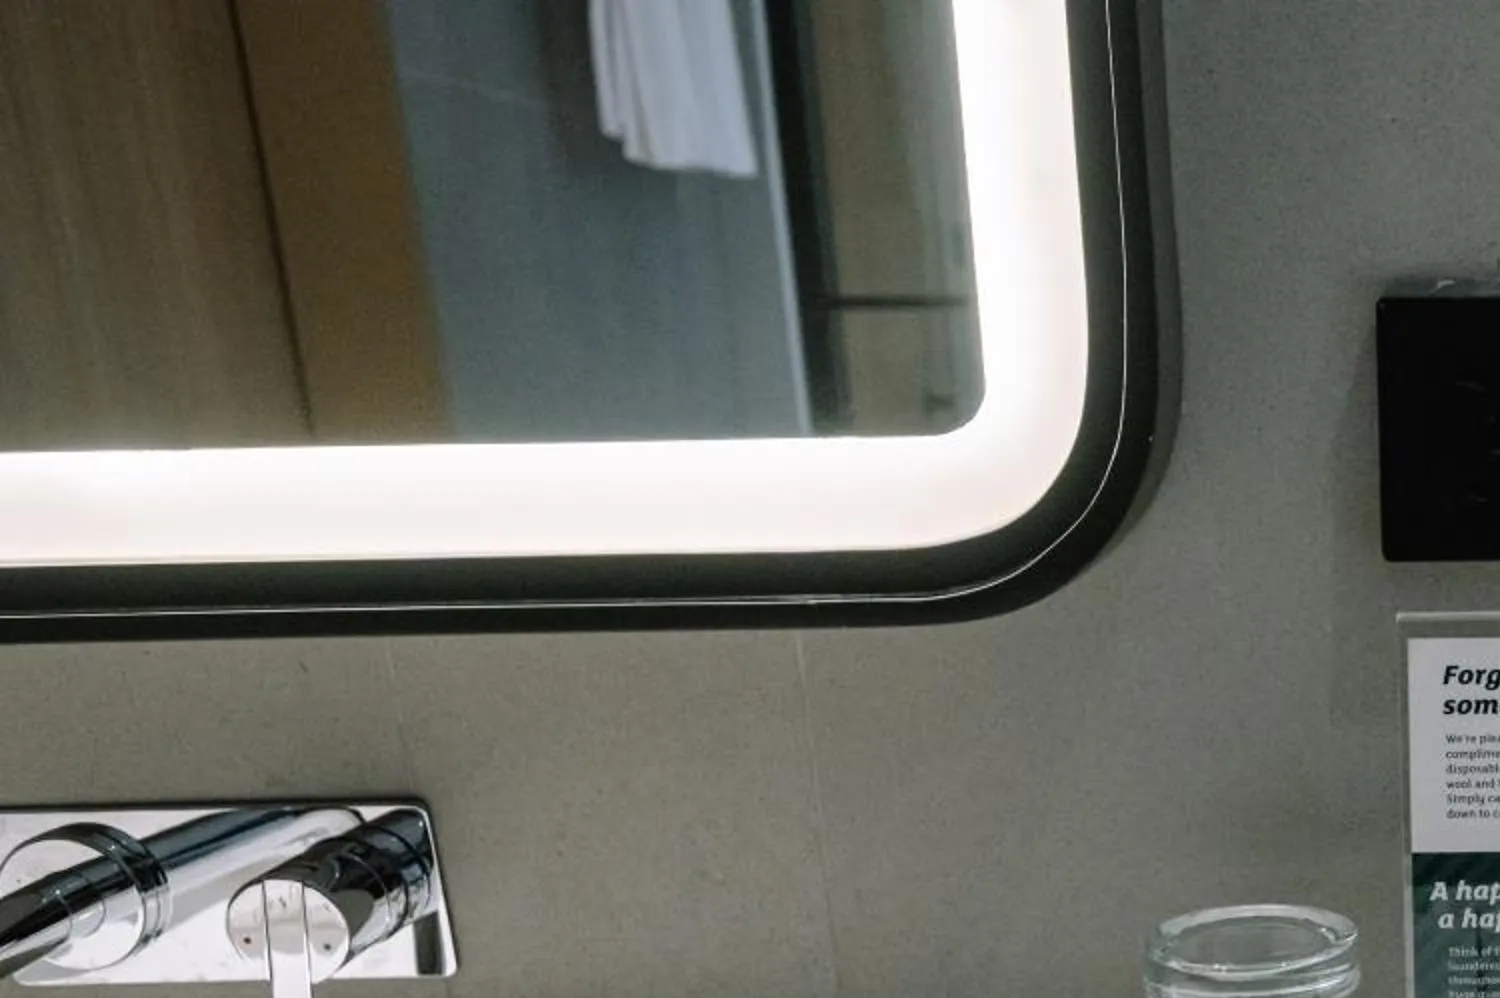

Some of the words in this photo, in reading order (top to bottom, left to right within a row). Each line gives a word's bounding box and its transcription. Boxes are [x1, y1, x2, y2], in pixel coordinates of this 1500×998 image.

[1445, 778, 1473, 789] wool
[1475, 778, 1495, 789] and
[1446, 793, 1485, 806] Simply
[1446, 807, 1476, 818] down
[1478, 807, 1491, 818] to
[1429, 880, 1449, 902] A
[1437, 911, 1455, 930] a
